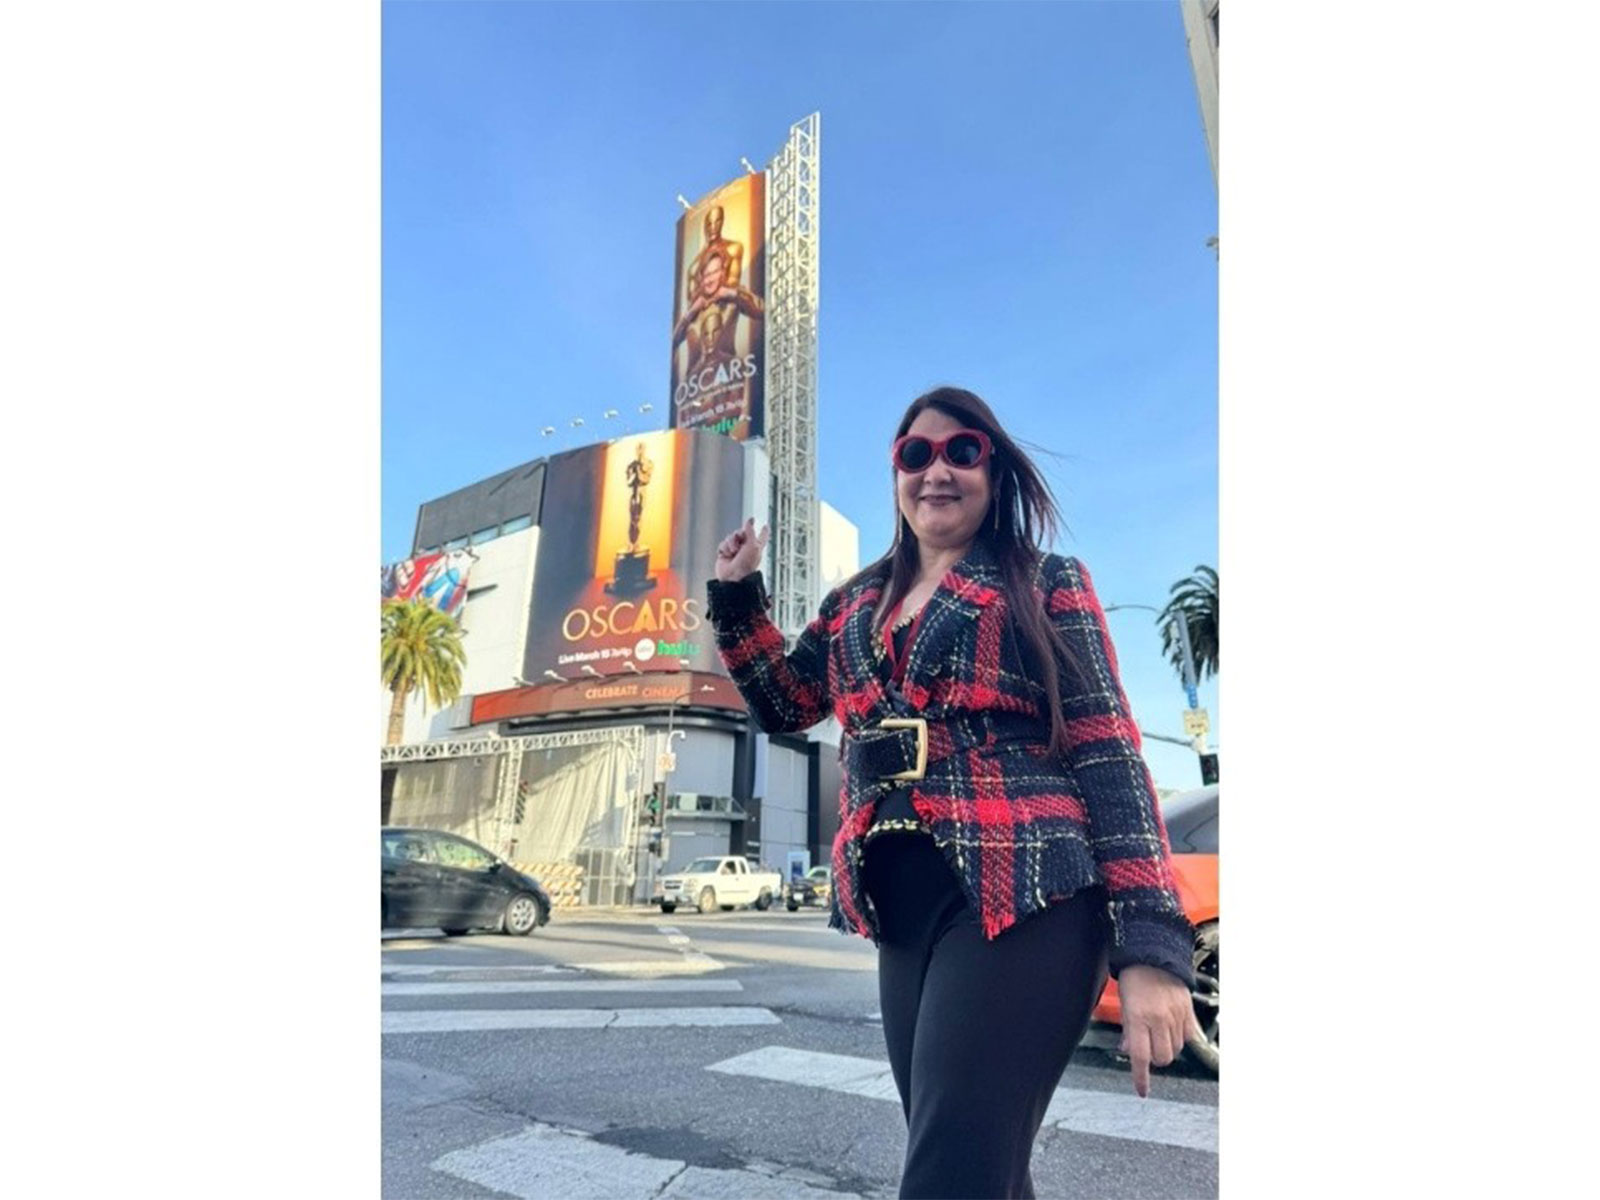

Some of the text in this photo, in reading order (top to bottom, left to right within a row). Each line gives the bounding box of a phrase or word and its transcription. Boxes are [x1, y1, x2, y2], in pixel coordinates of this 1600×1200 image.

[675, 354, 757, 405] OSCARS
[562, 598, 701, 641] OSCARS
[575, 650, 600, 662] March
[585, 684, 686, 699] CELEBRATE CINEMA
